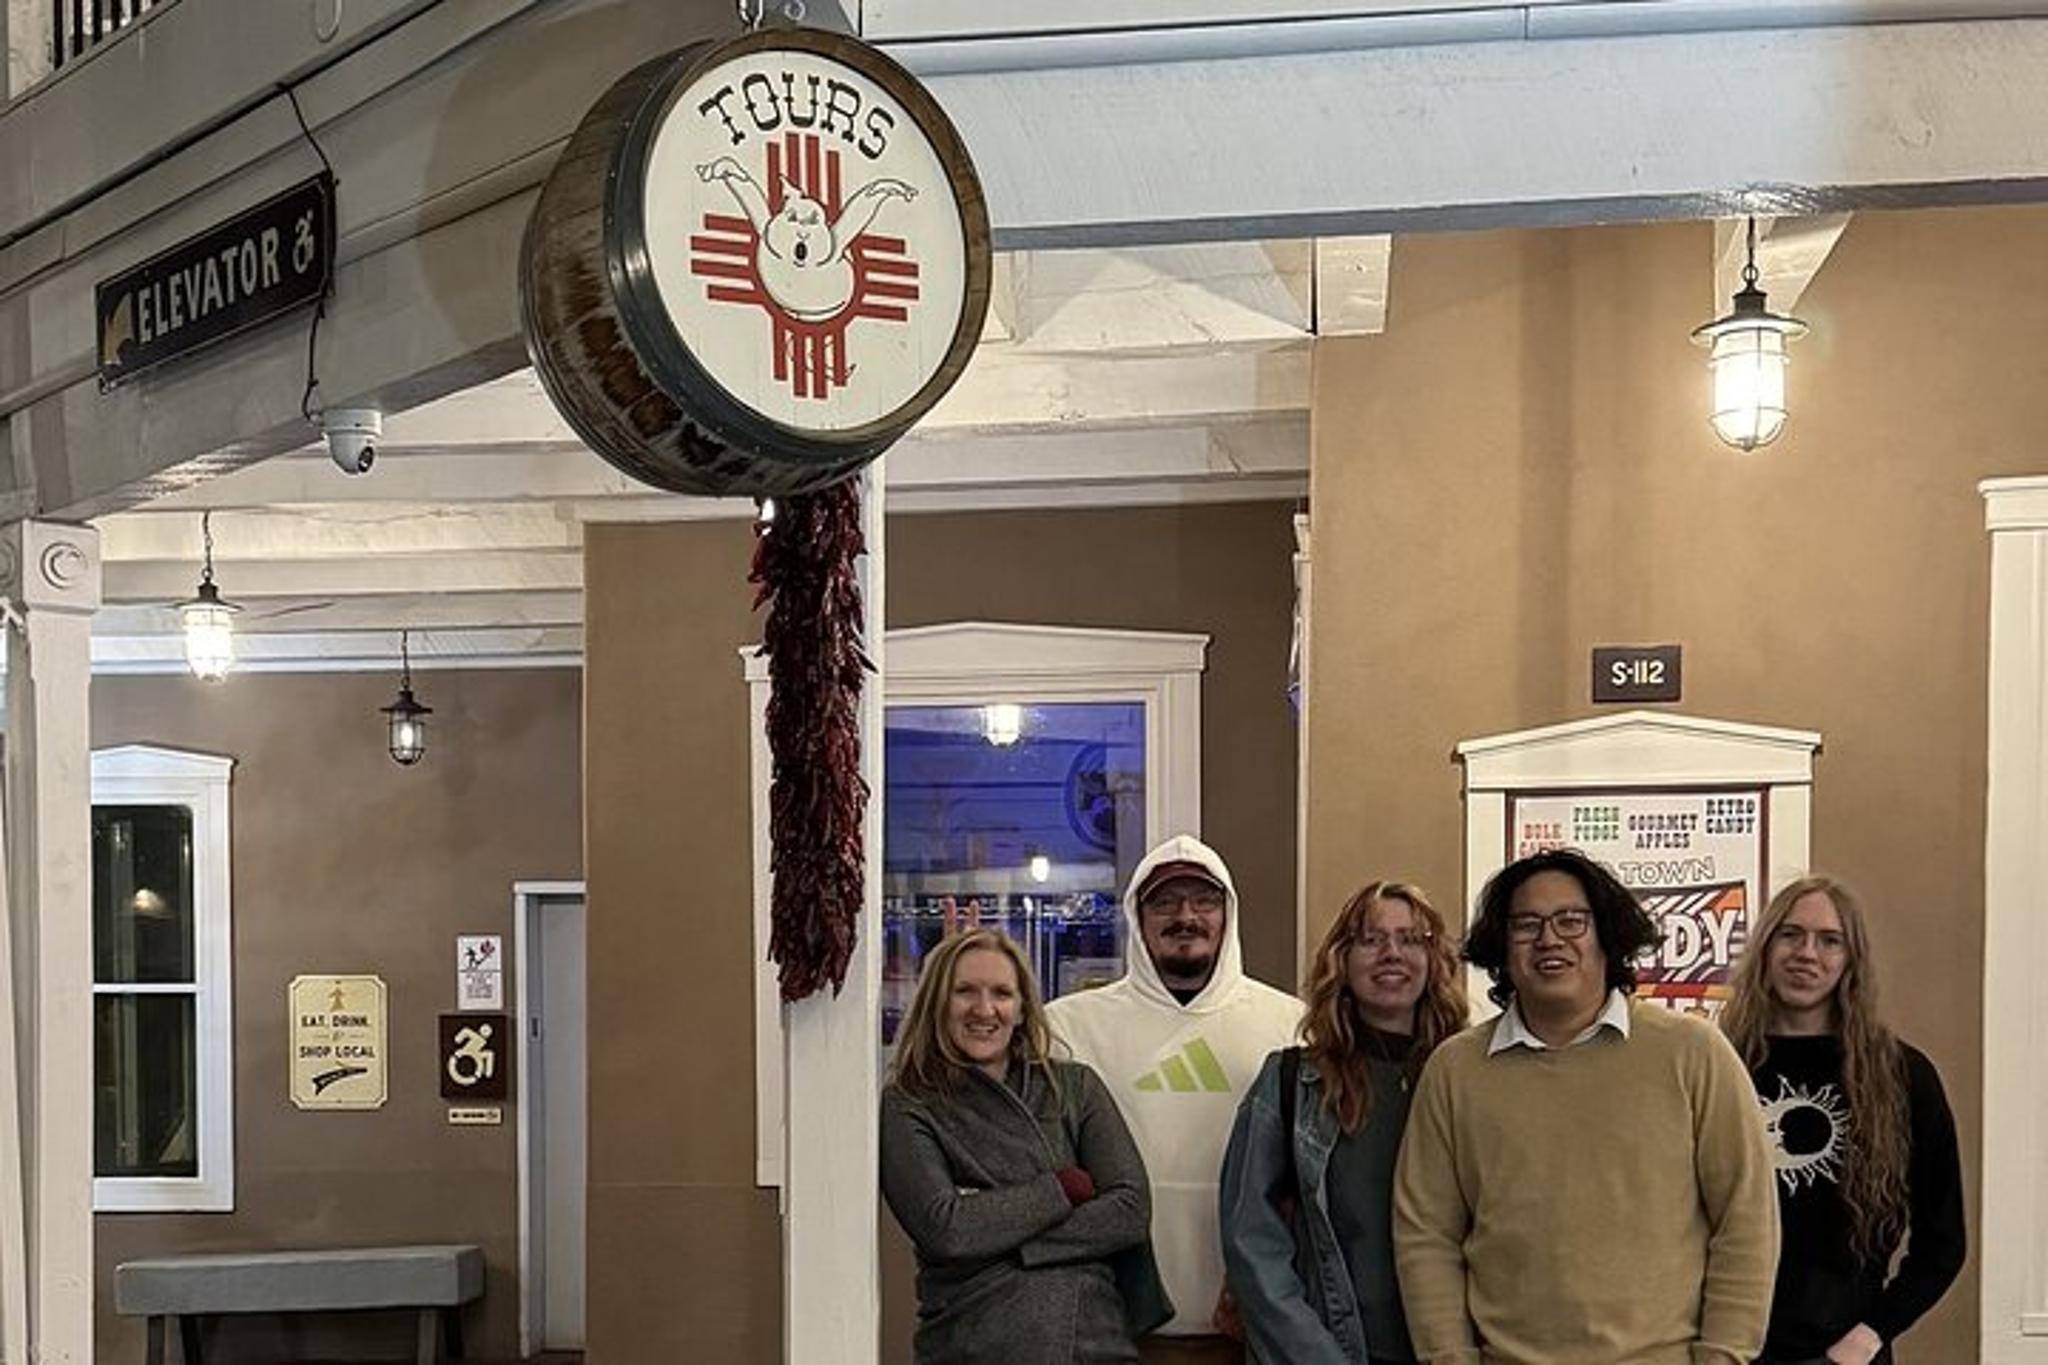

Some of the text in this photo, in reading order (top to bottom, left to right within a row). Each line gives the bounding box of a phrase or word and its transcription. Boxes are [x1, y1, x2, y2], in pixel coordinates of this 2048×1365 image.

[698, 72, 894, 159] TOURS
[138, 227, 281, 343] ELEVATOR
[1611, 660, 1664, 686] S-112
[1573, 807, 1619, 822] FRESH
[1706, 799, 1755, 815] RETRO
[1628, 814, 1698, 830] GOURMET
[1705, 818, 1755, 833] CANDY
[1573, 825, 1619, 839] FUDGE
[1635, 833, 1690, 848] APPLES
[1620, 855, 1715, 885] TOWN
[300, 1046, 376, 1058] SHOP LOCAL
